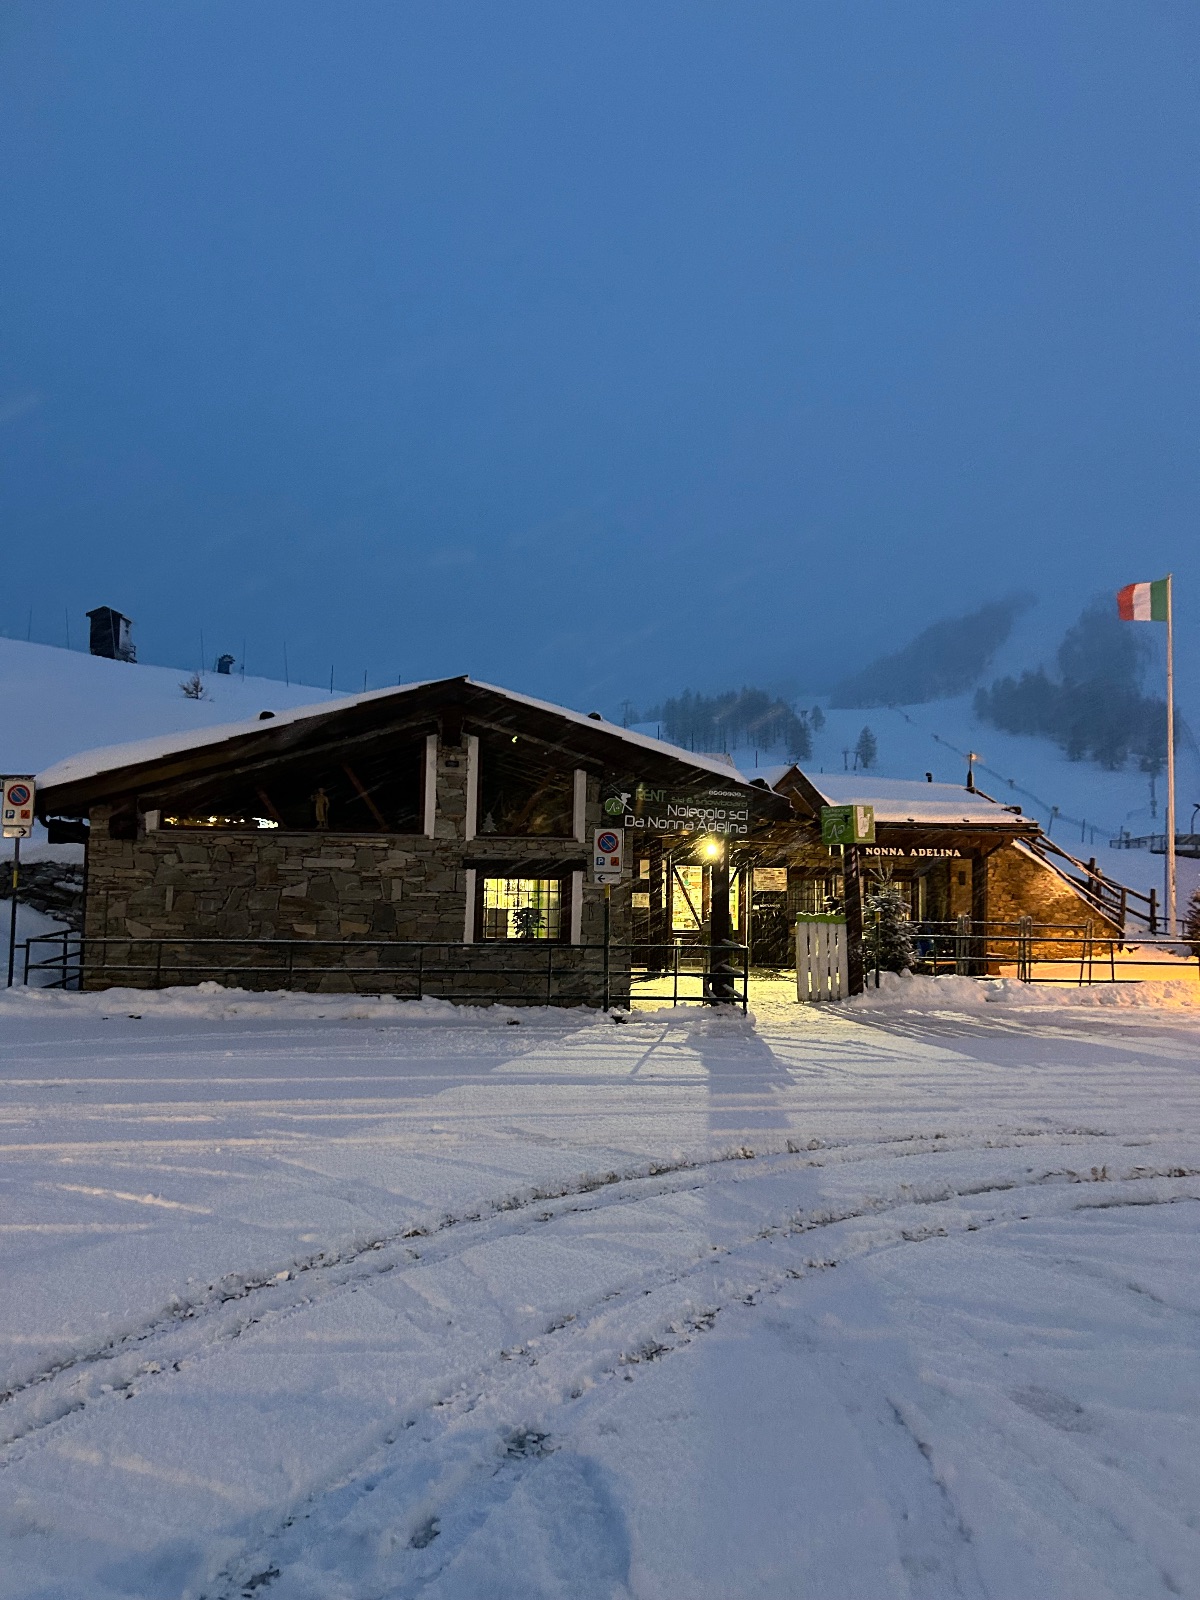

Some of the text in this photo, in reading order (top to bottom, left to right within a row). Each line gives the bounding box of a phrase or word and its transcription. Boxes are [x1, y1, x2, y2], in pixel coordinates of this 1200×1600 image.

[635, 788, 667, 802] RENT
[667, 804, 749, 821] Noleggio sci
[624, 815, 748, 834] Da Nonna Adelina
[865, 847, 962, 857] NONNA ADELINA
